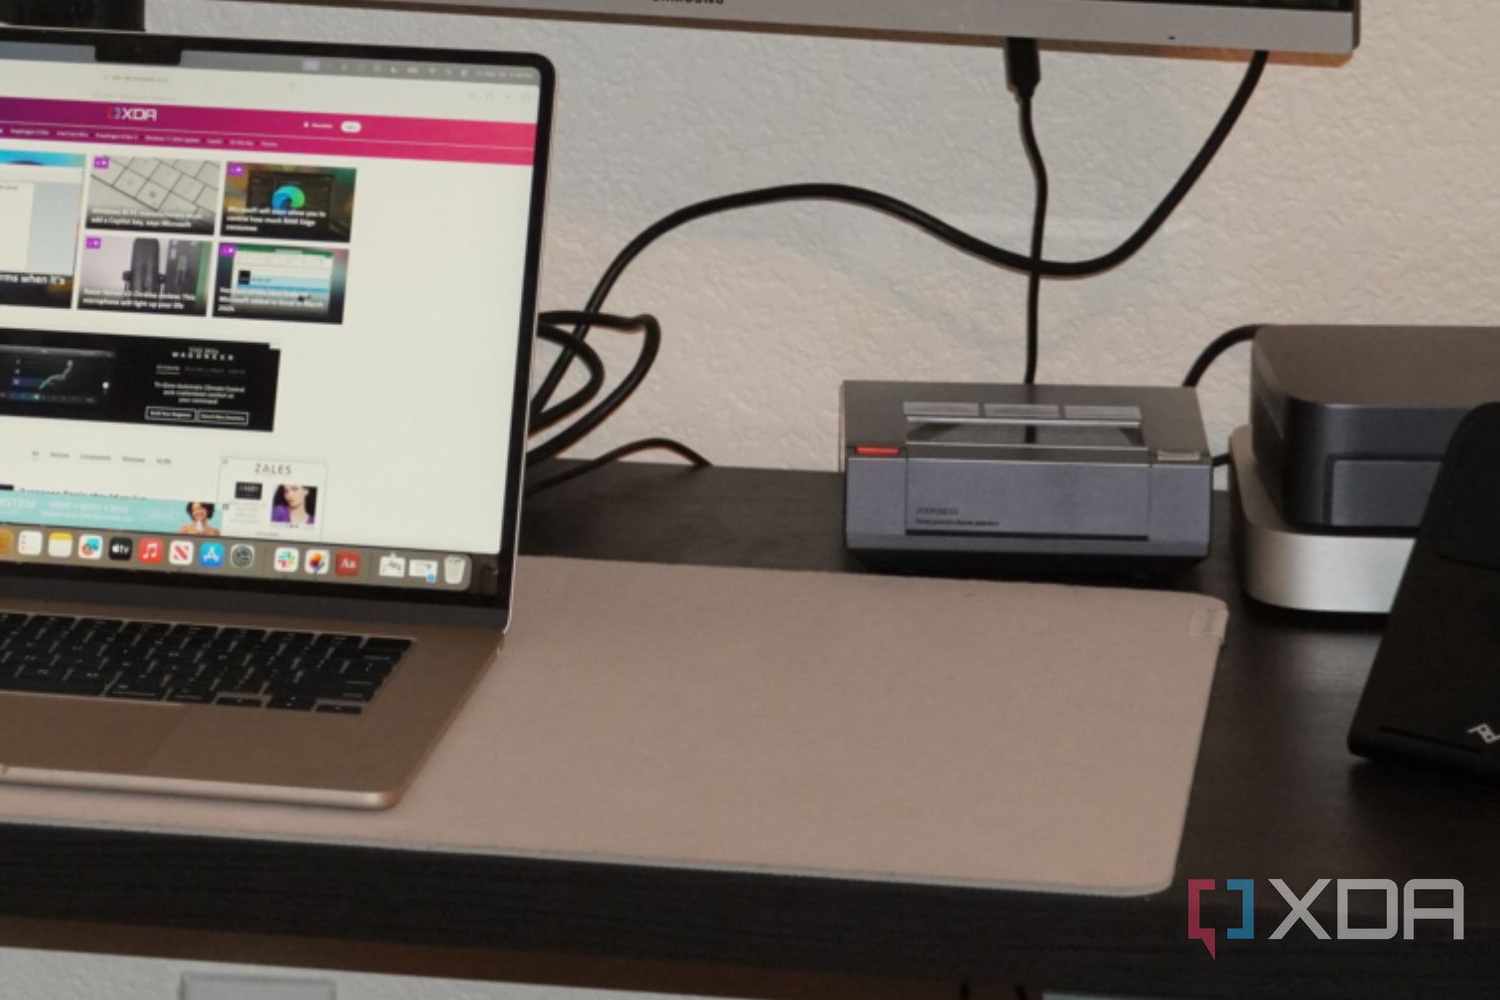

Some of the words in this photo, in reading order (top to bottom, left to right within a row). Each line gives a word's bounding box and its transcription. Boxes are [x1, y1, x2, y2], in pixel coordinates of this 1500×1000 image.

[122, 107, 157, 121] XDA
[21, 272, 47, 284] when
[49, 274, 65, 285] it's
[255, 463, 292, 476] ZALES
[339, 559, 356, 569] Aa
